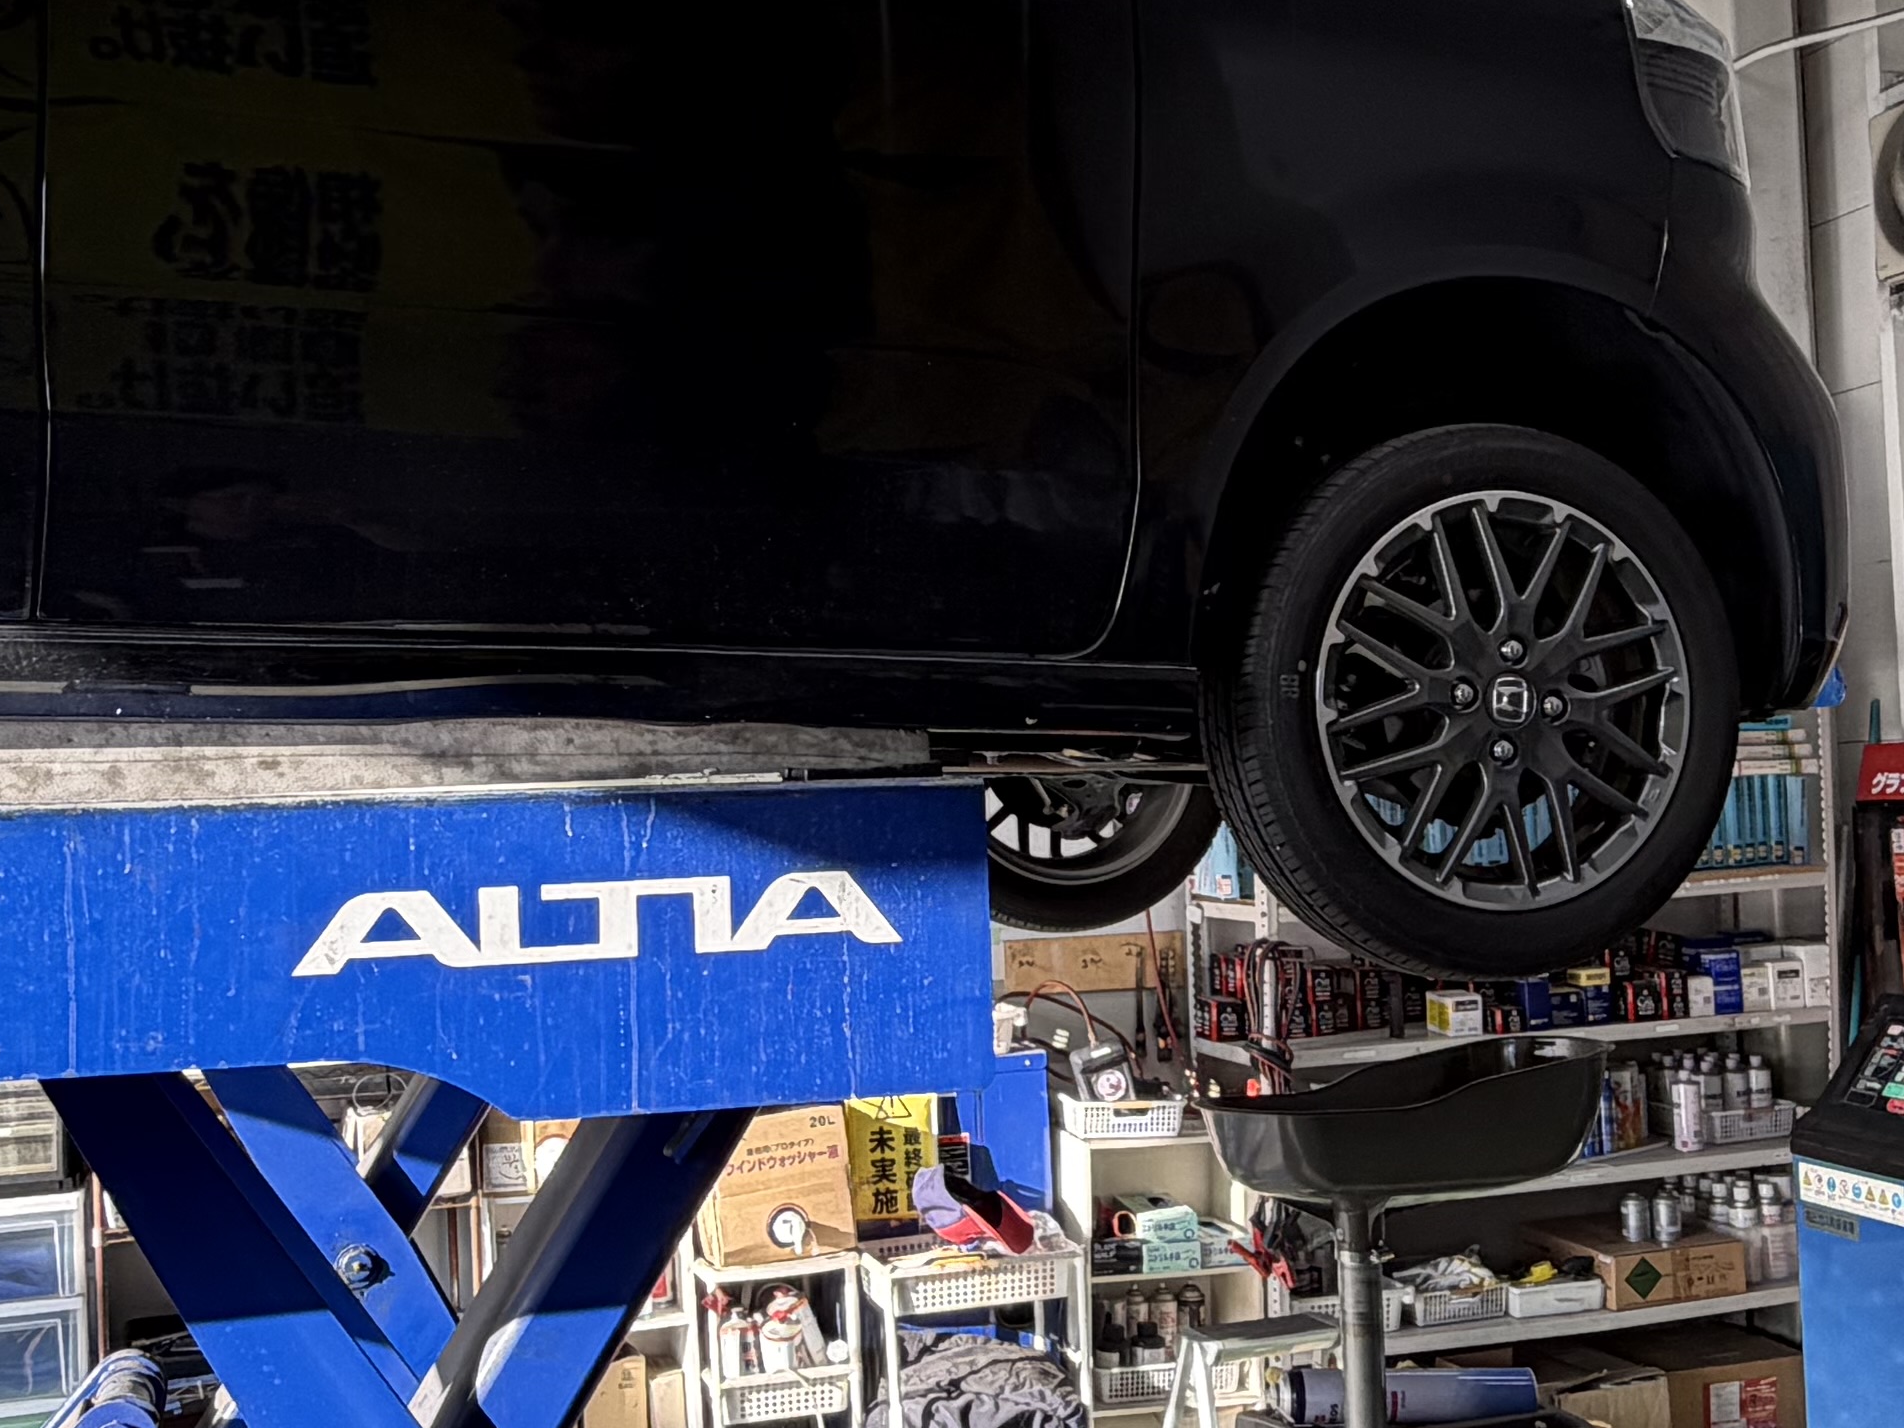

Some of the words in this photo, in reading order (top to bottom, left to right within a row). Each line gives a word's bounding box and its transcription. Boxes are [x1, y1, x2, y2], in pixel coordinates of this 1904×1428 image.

[292, 870, 903, 977] ALTIA
[809, 1115, 836, 1129] 20L
[868, 1126, 900, 1215] 未実施
